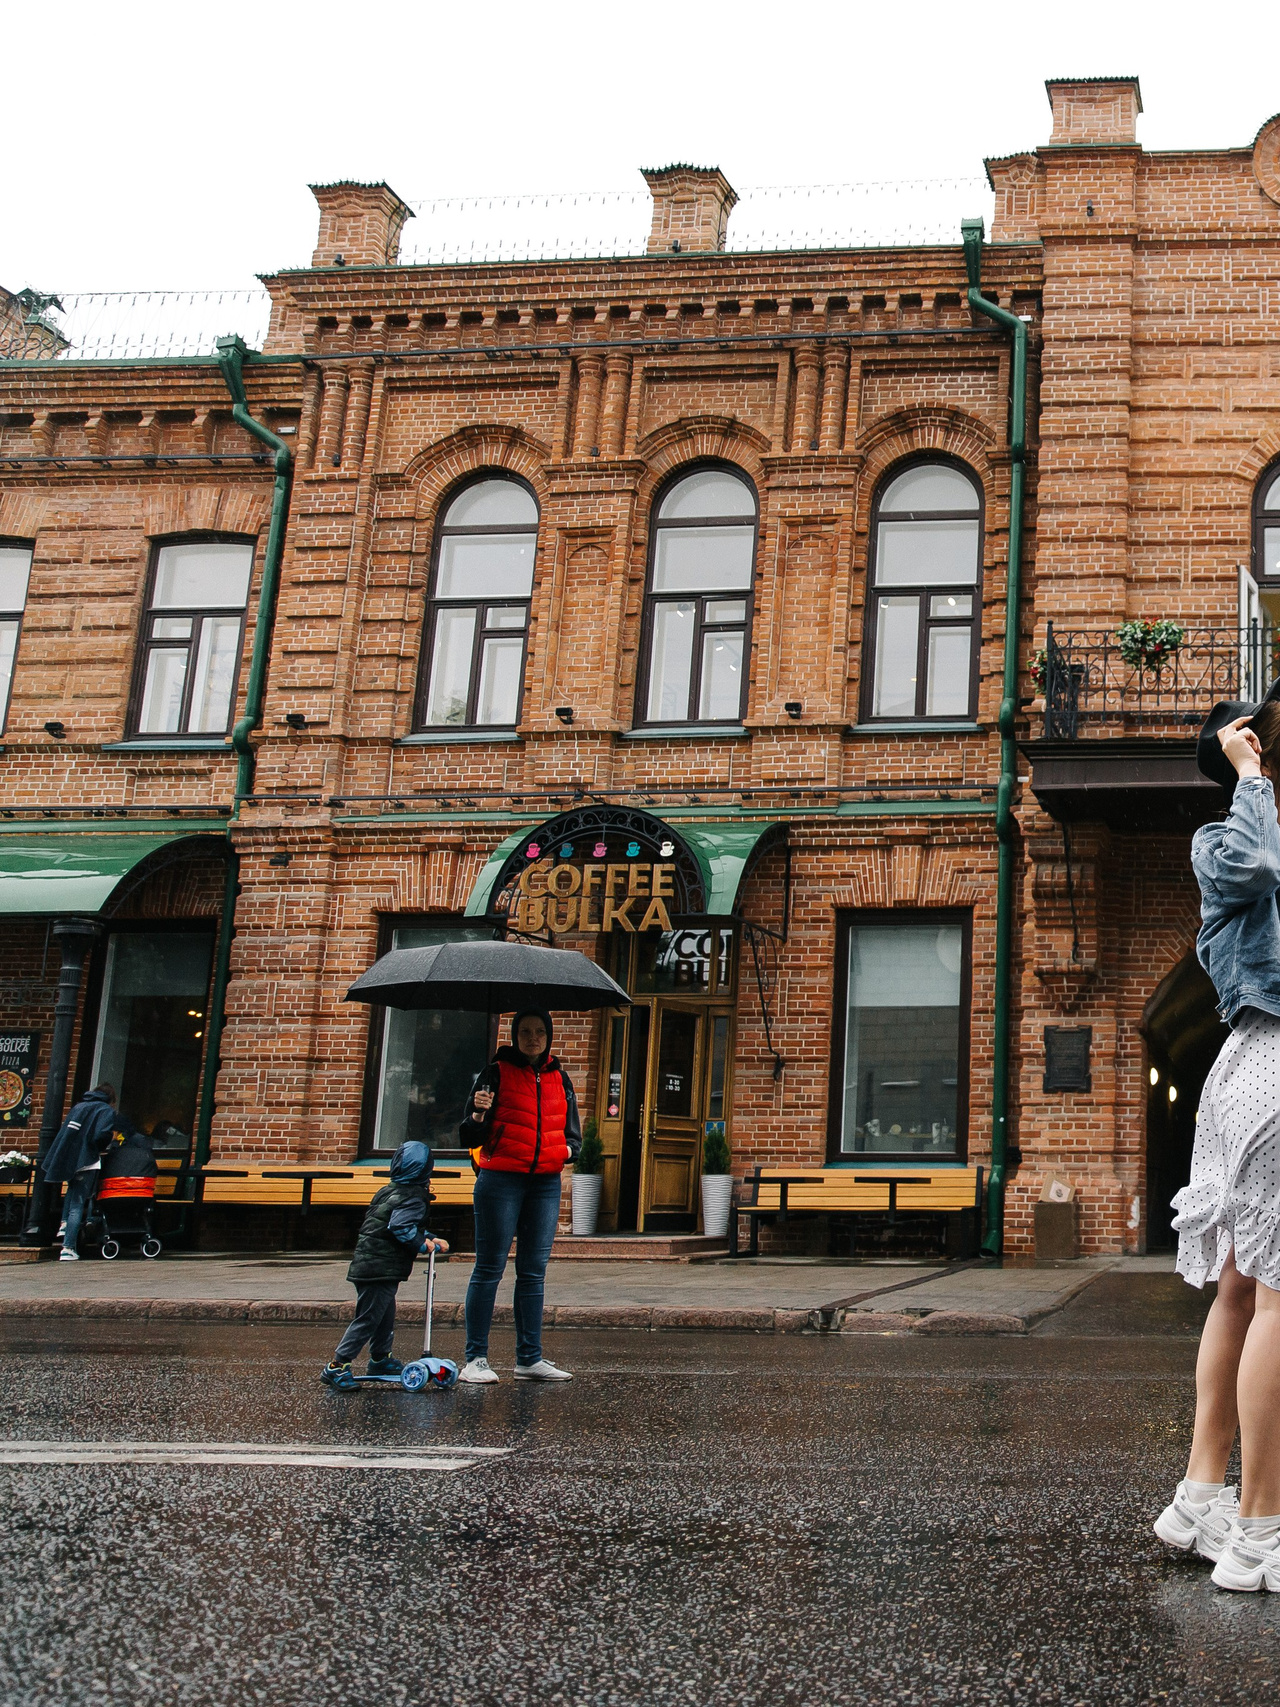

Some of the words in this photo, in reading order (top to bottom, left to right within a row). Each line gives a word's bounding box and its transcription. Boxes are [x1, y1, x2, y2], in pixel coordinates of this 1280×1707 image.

[519, 863, 675, 897] COFFEE
[518, 897, 673, 933] BULKA
[1, 1055, 20, 1066] PIZZA
